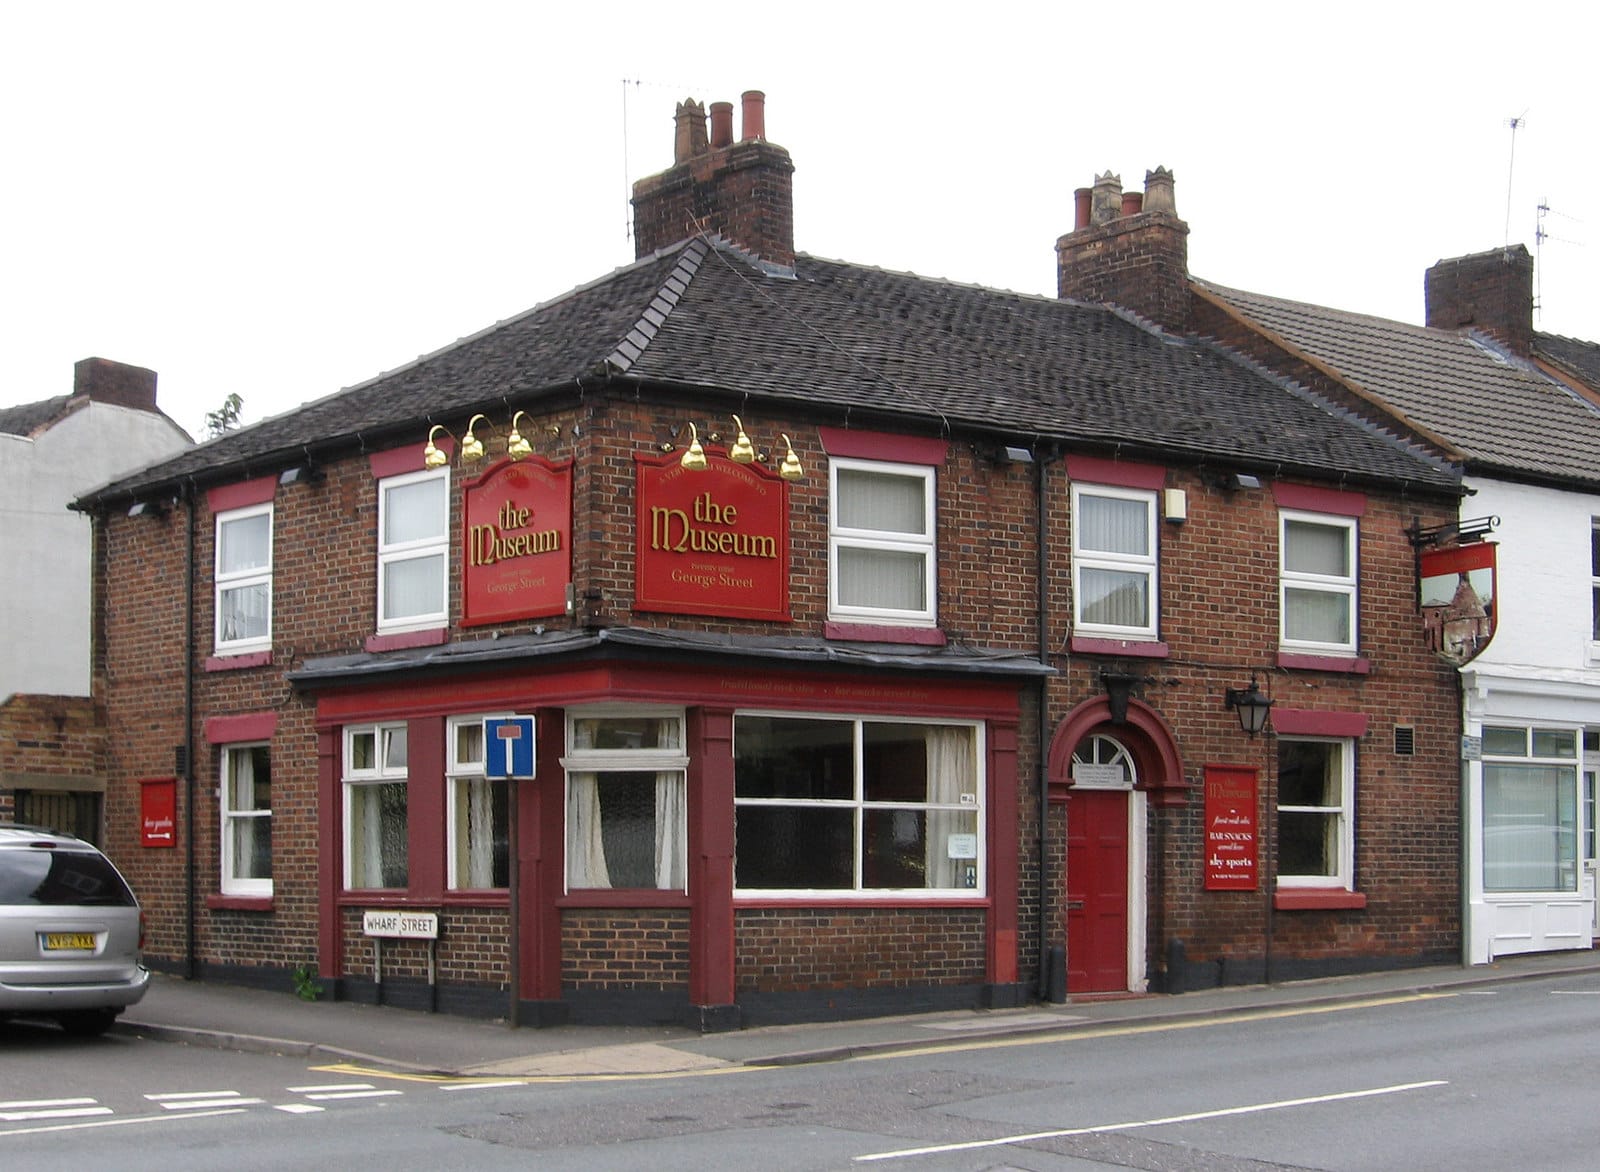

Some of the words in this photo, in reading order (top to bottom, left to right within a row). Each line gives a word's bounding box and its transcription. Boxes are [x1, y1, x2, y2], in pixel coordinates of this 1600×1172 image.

[498, 500, 530, 531] the
[694, 492, 738, 525] the
[470, 523, 561, 567] Museum
[651, 505, 778, 559] Museum
[486, 580, 518, 595] George
[520, 576, 546, 589] Street
[671, 568, 717, 589] George
[719, 573, 754, 588] Street
[1210, 853, 1223, 869] sky
[1226, 858, 1252, 869] sports
[366, 918, 397, 930] WHARF
[401, 918, 433, 932] STREET
